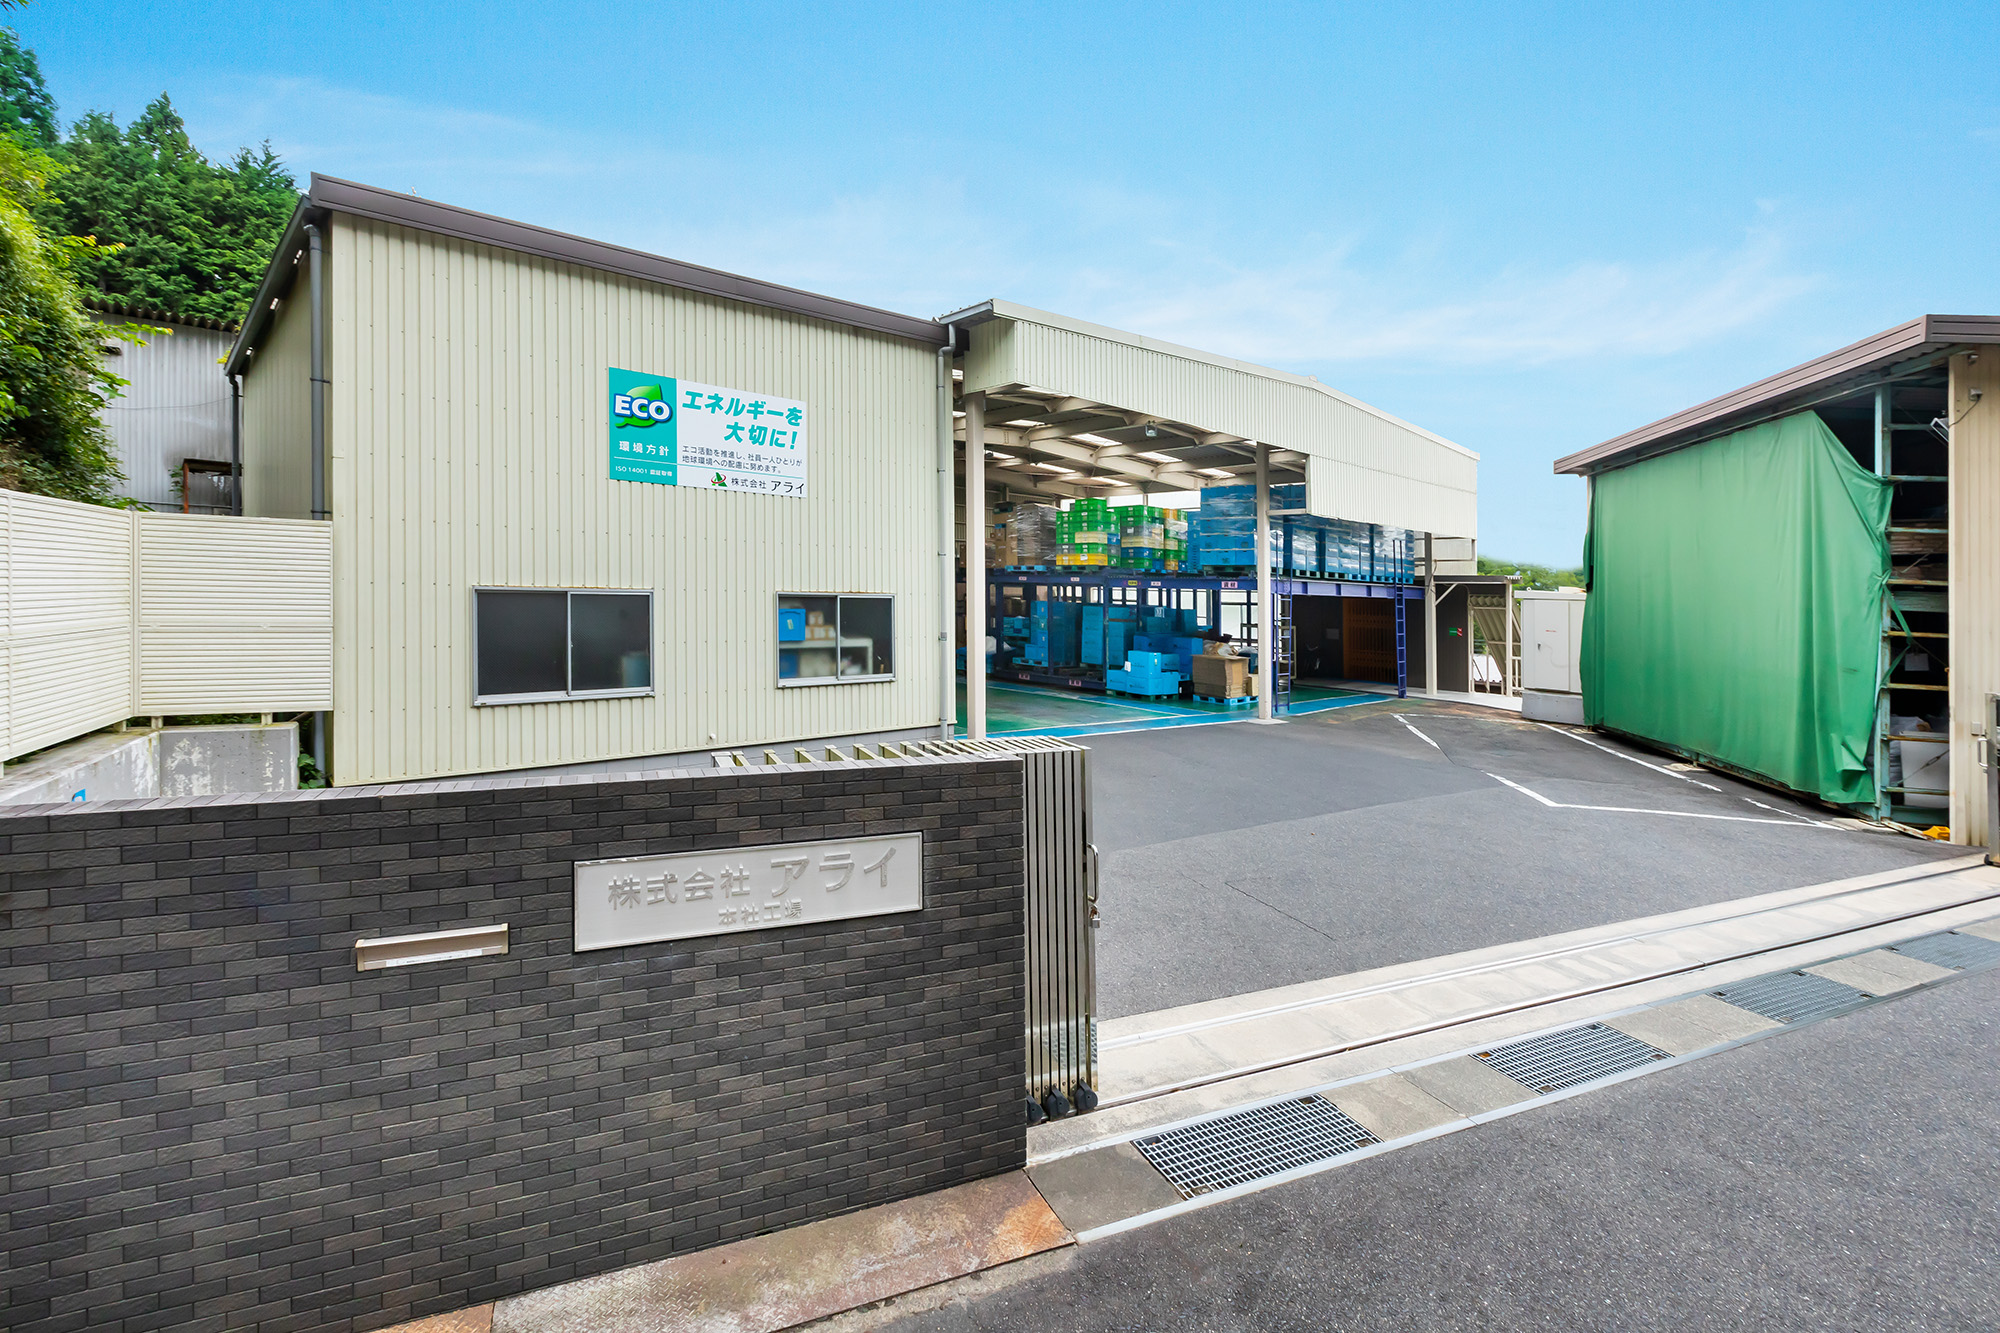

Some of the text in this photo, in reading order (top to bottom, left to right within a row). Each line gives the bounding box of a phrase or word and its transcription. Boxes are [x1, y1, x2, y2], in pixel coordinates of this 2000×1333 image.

[613, 394, 672, 421] ECO
[682, 390, 802, 426] エネルギーを
[618, 440, 669, 456] 環境方針
[731, 477, 804, 494] 株式会社 アライ
[608, 846, 897, 911] 株式会社 アライ
[718, 898, 803, 926] 本社工場
